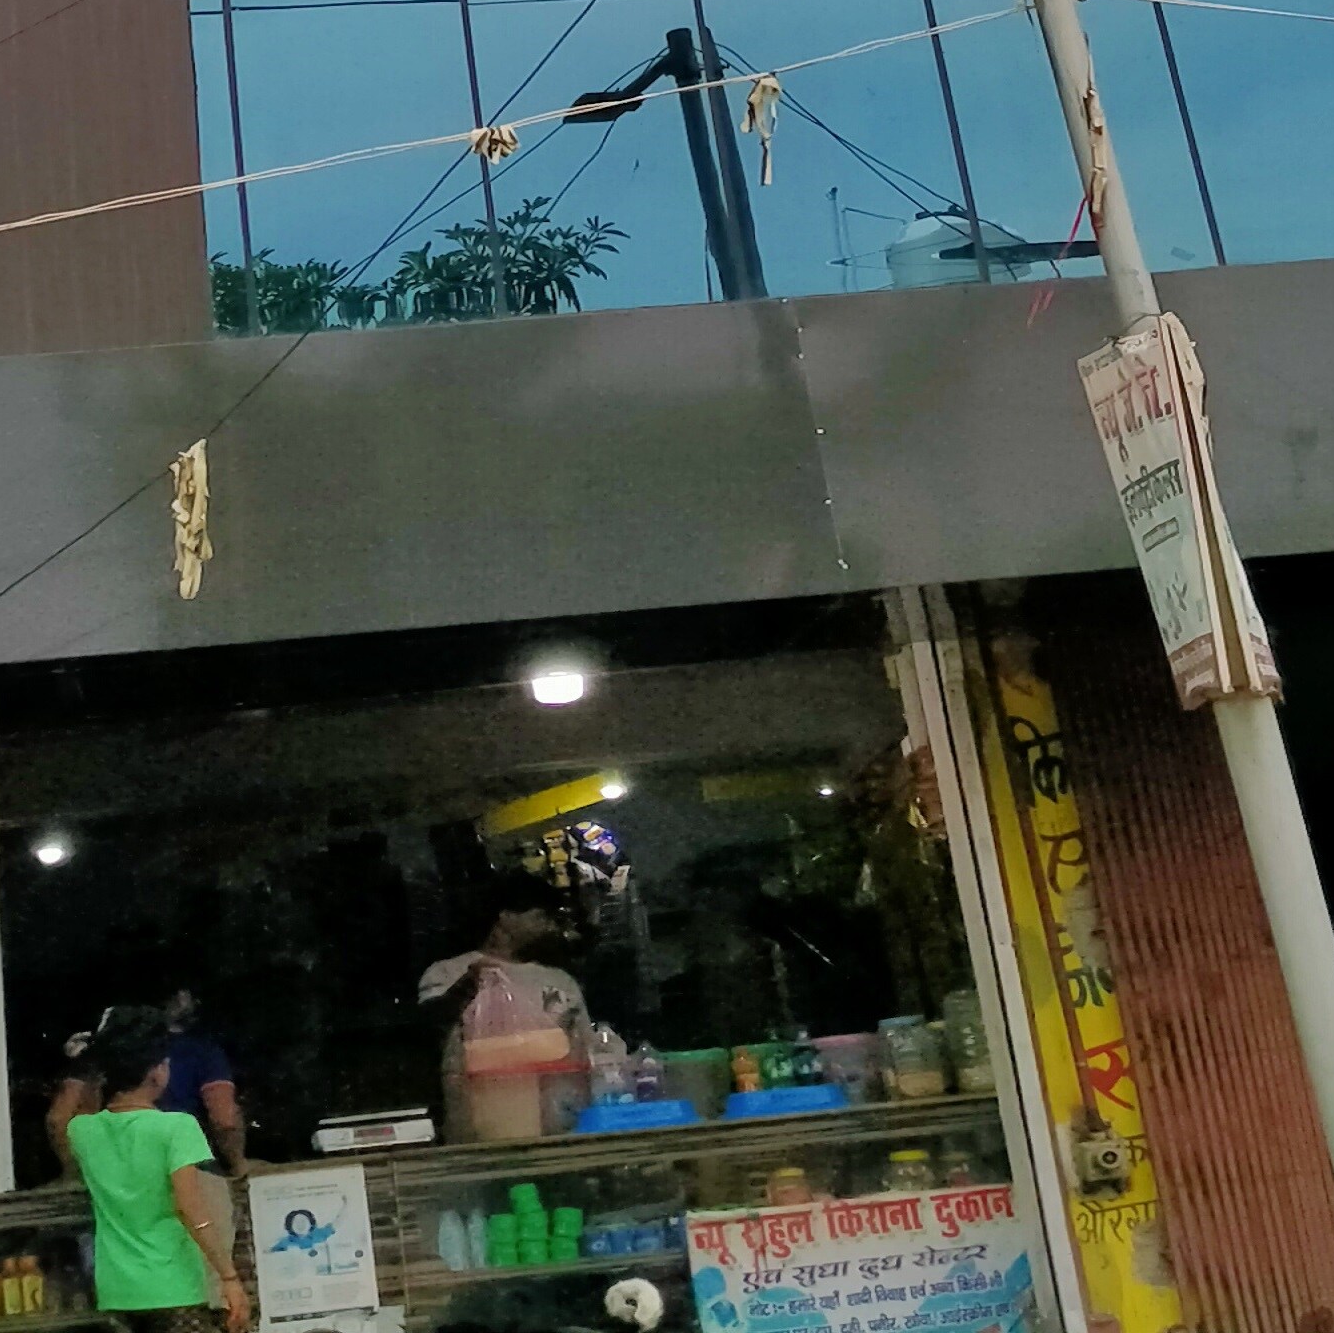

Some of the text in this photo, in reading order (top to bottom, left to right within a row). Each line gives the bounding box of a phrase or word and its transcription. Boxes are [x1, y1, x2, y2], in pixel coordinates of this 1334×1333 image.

[690, 1187, 1014, 1265] न्यू राहुल किराना दुकान
[792, 1261, 850, 1288] सुधा
